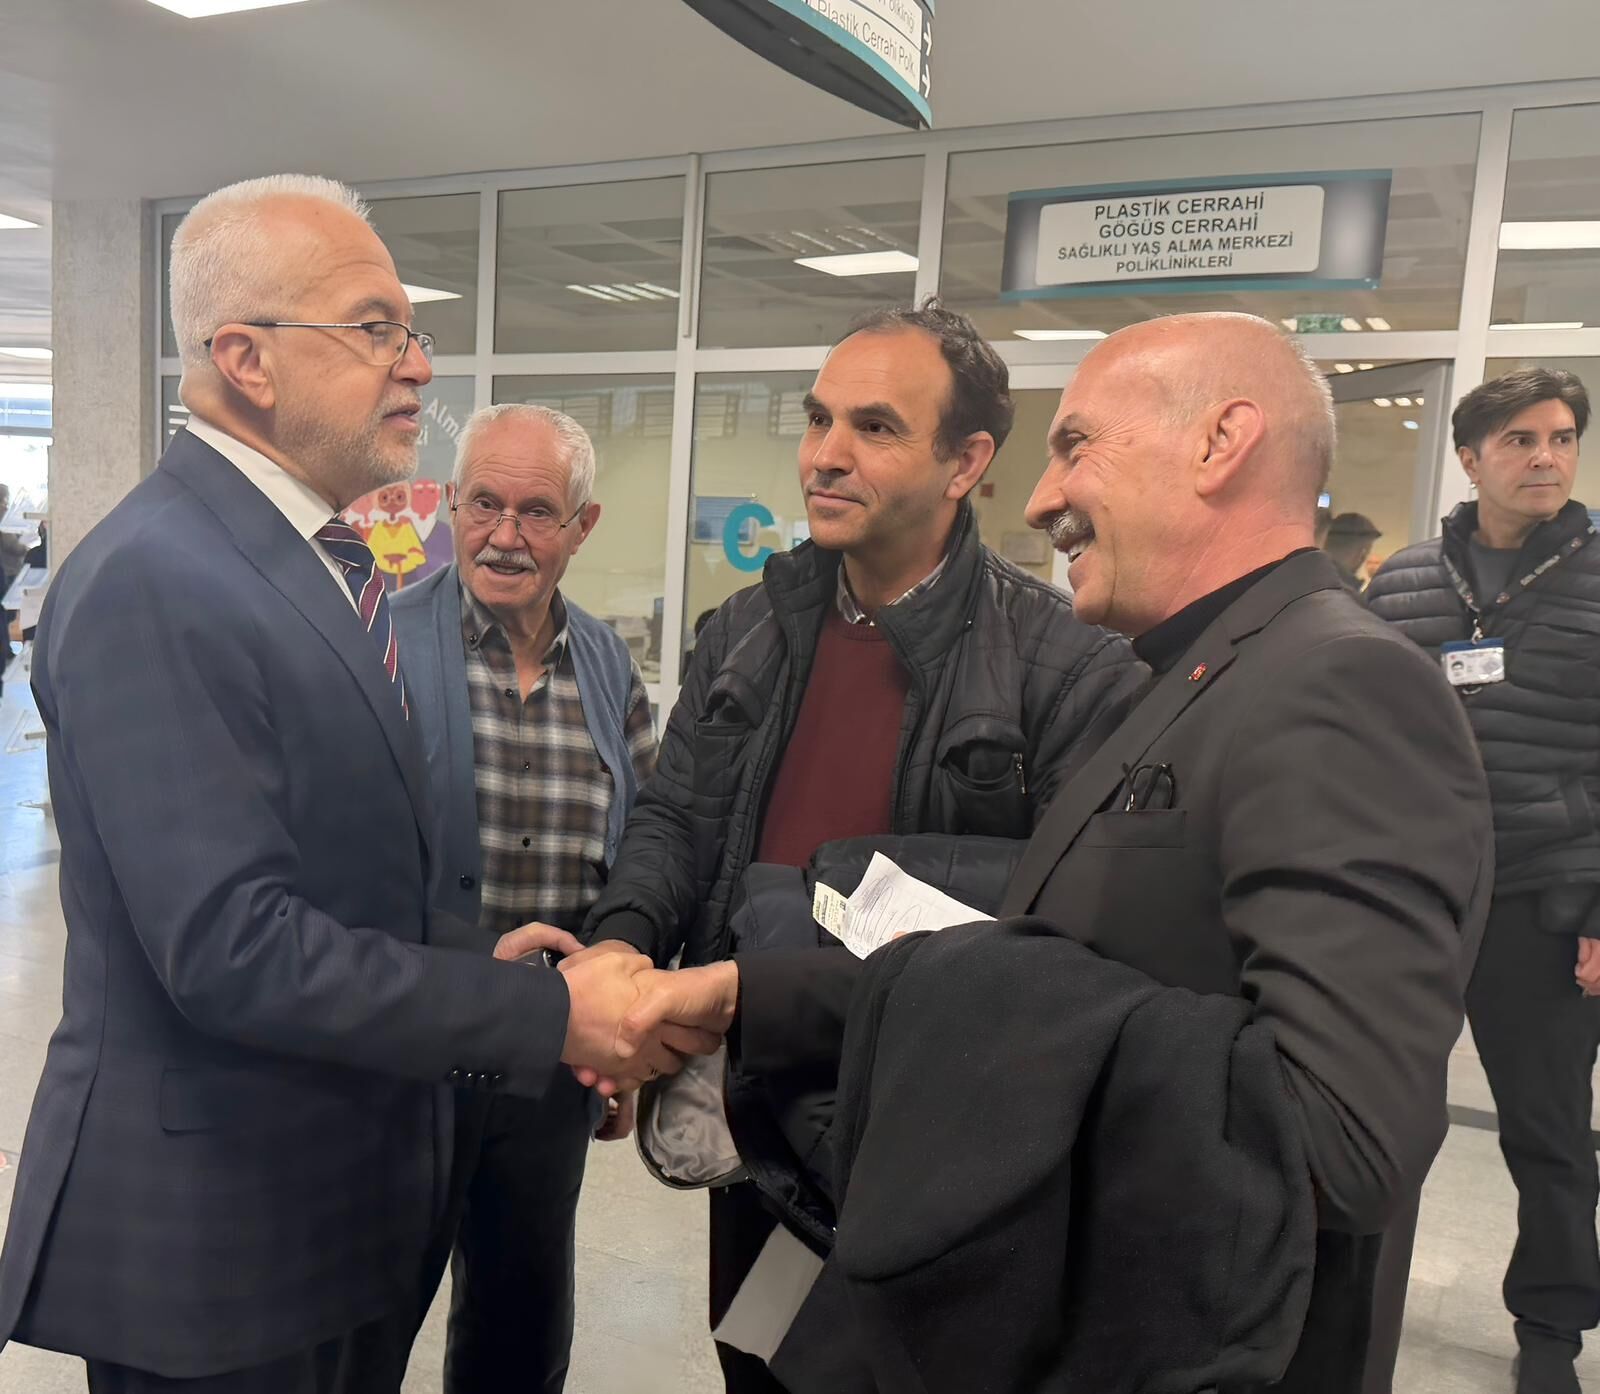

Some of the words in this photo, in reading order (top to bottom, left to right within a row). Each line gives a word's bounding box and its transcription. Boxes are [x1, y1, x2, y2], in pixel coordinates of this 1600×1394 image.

[817, 0, 859, 38] Plastik
[862, 22, 897, 61] Cerrahi
[1095, 198, 1170, 220] PLASTİK
[1177, 192, 1264, 214] CERRAHİ
[1171, 212, 1258, 234] CERRAHİ
[1057, 242, 1127, 260] SAĞLIKLI
[1131, 240, 1161, 256] YAŞ
[1167, 238, 1213, 253] ALMA
[1218, 231, 1293, 250] MERKEZİ
[1116, 252, 1232, 273] POLİKLİNİKLERİ
